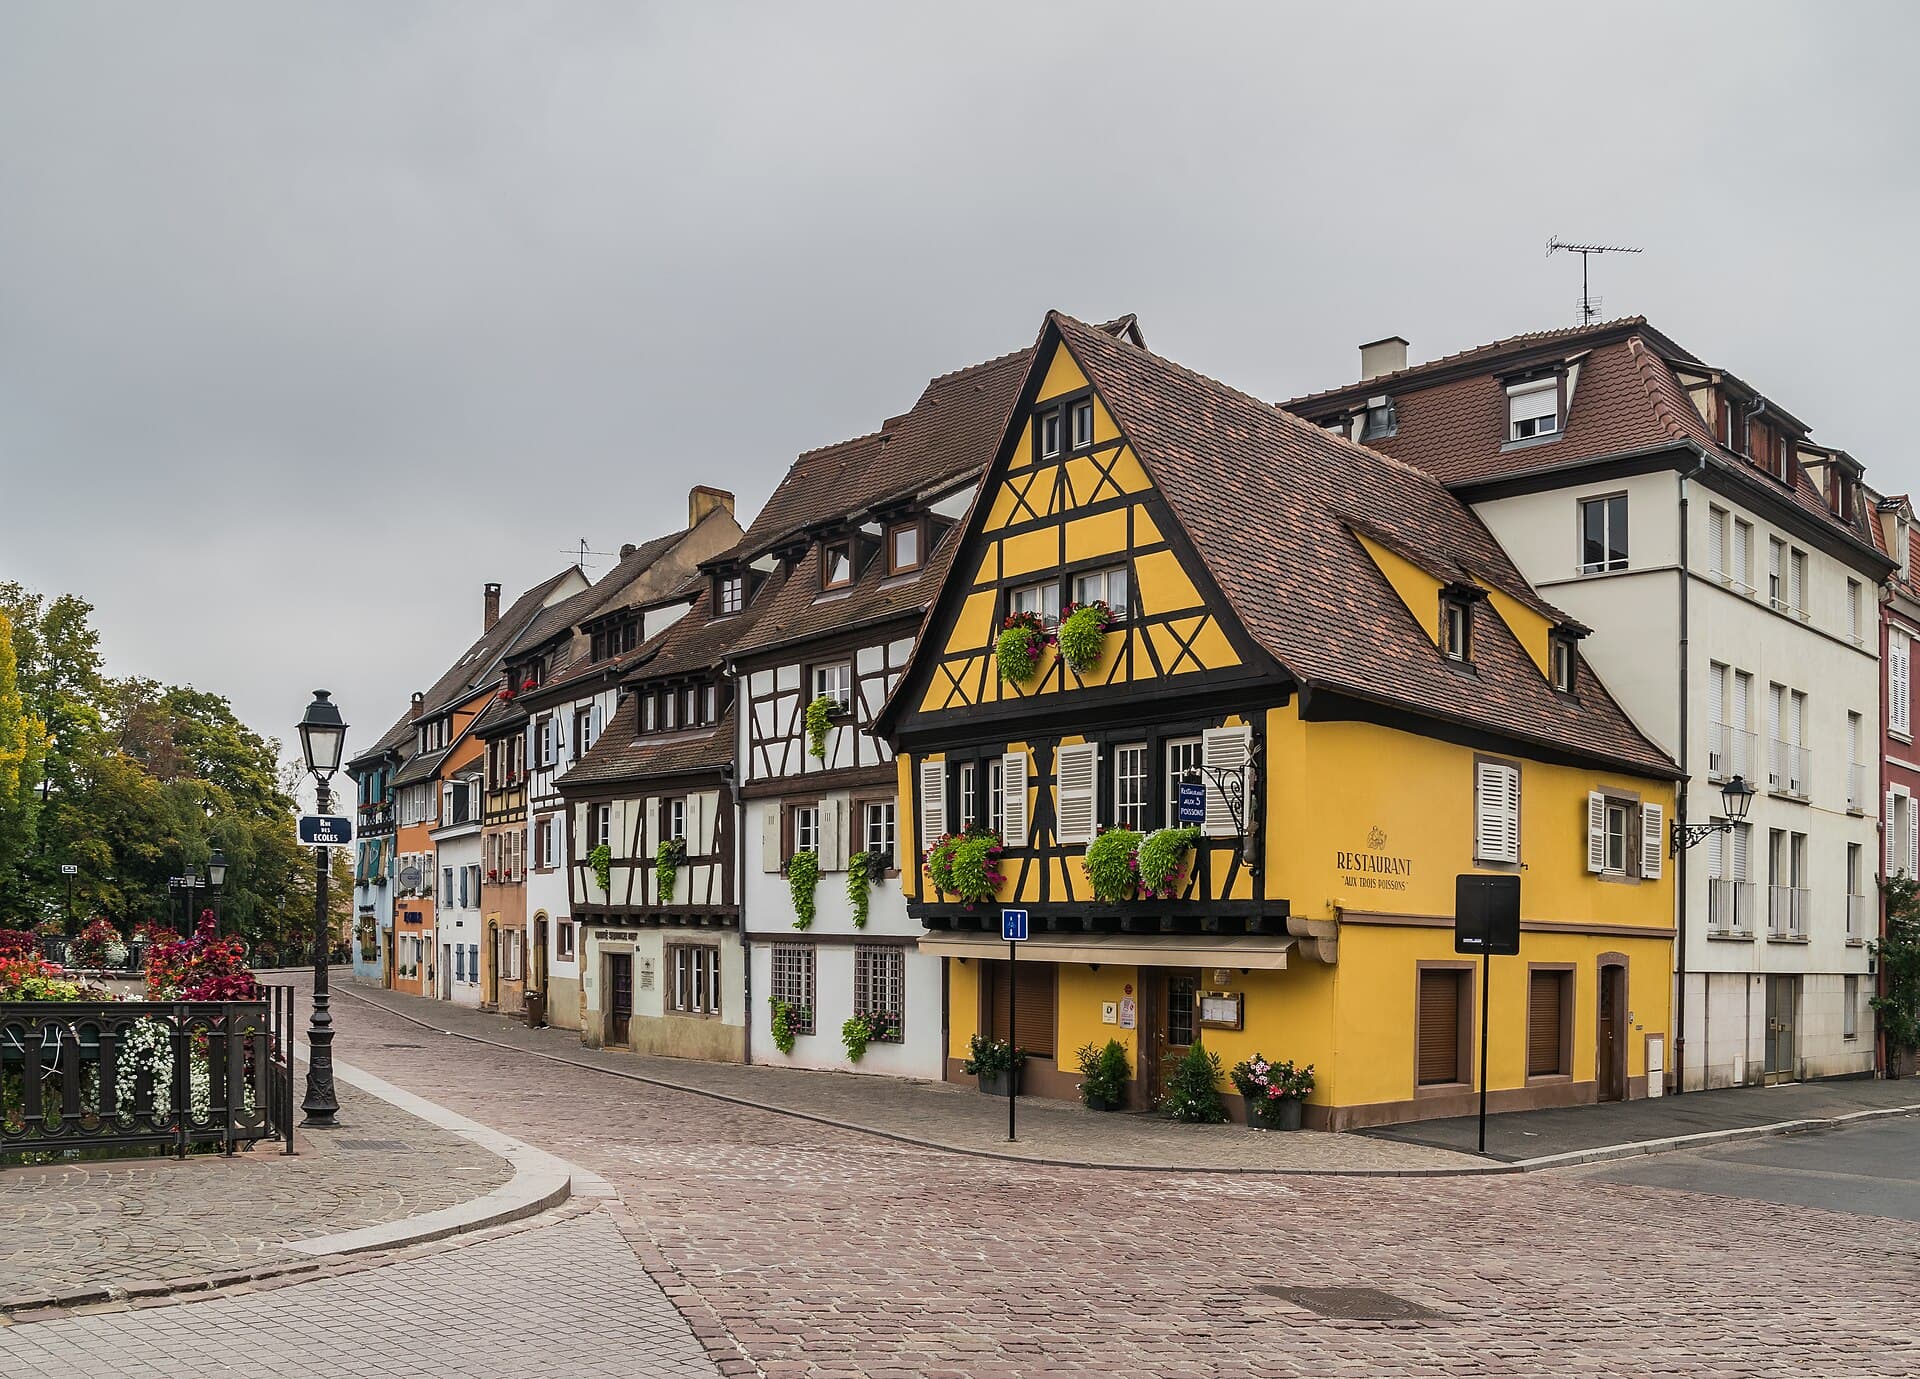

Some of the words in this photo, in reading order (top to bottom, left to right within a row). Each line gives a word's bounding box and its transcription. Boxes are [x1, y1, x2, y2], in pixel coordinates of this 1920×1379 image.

[1195, 797, 1201, 806] 3
[1180, 807, 1204, 817] POISSONS
[313, 833, 339, 842] ECOLES
[1337, 851, 1412, 876] RESTAURANT
[1359, 877, 1377, 889] TROIS
